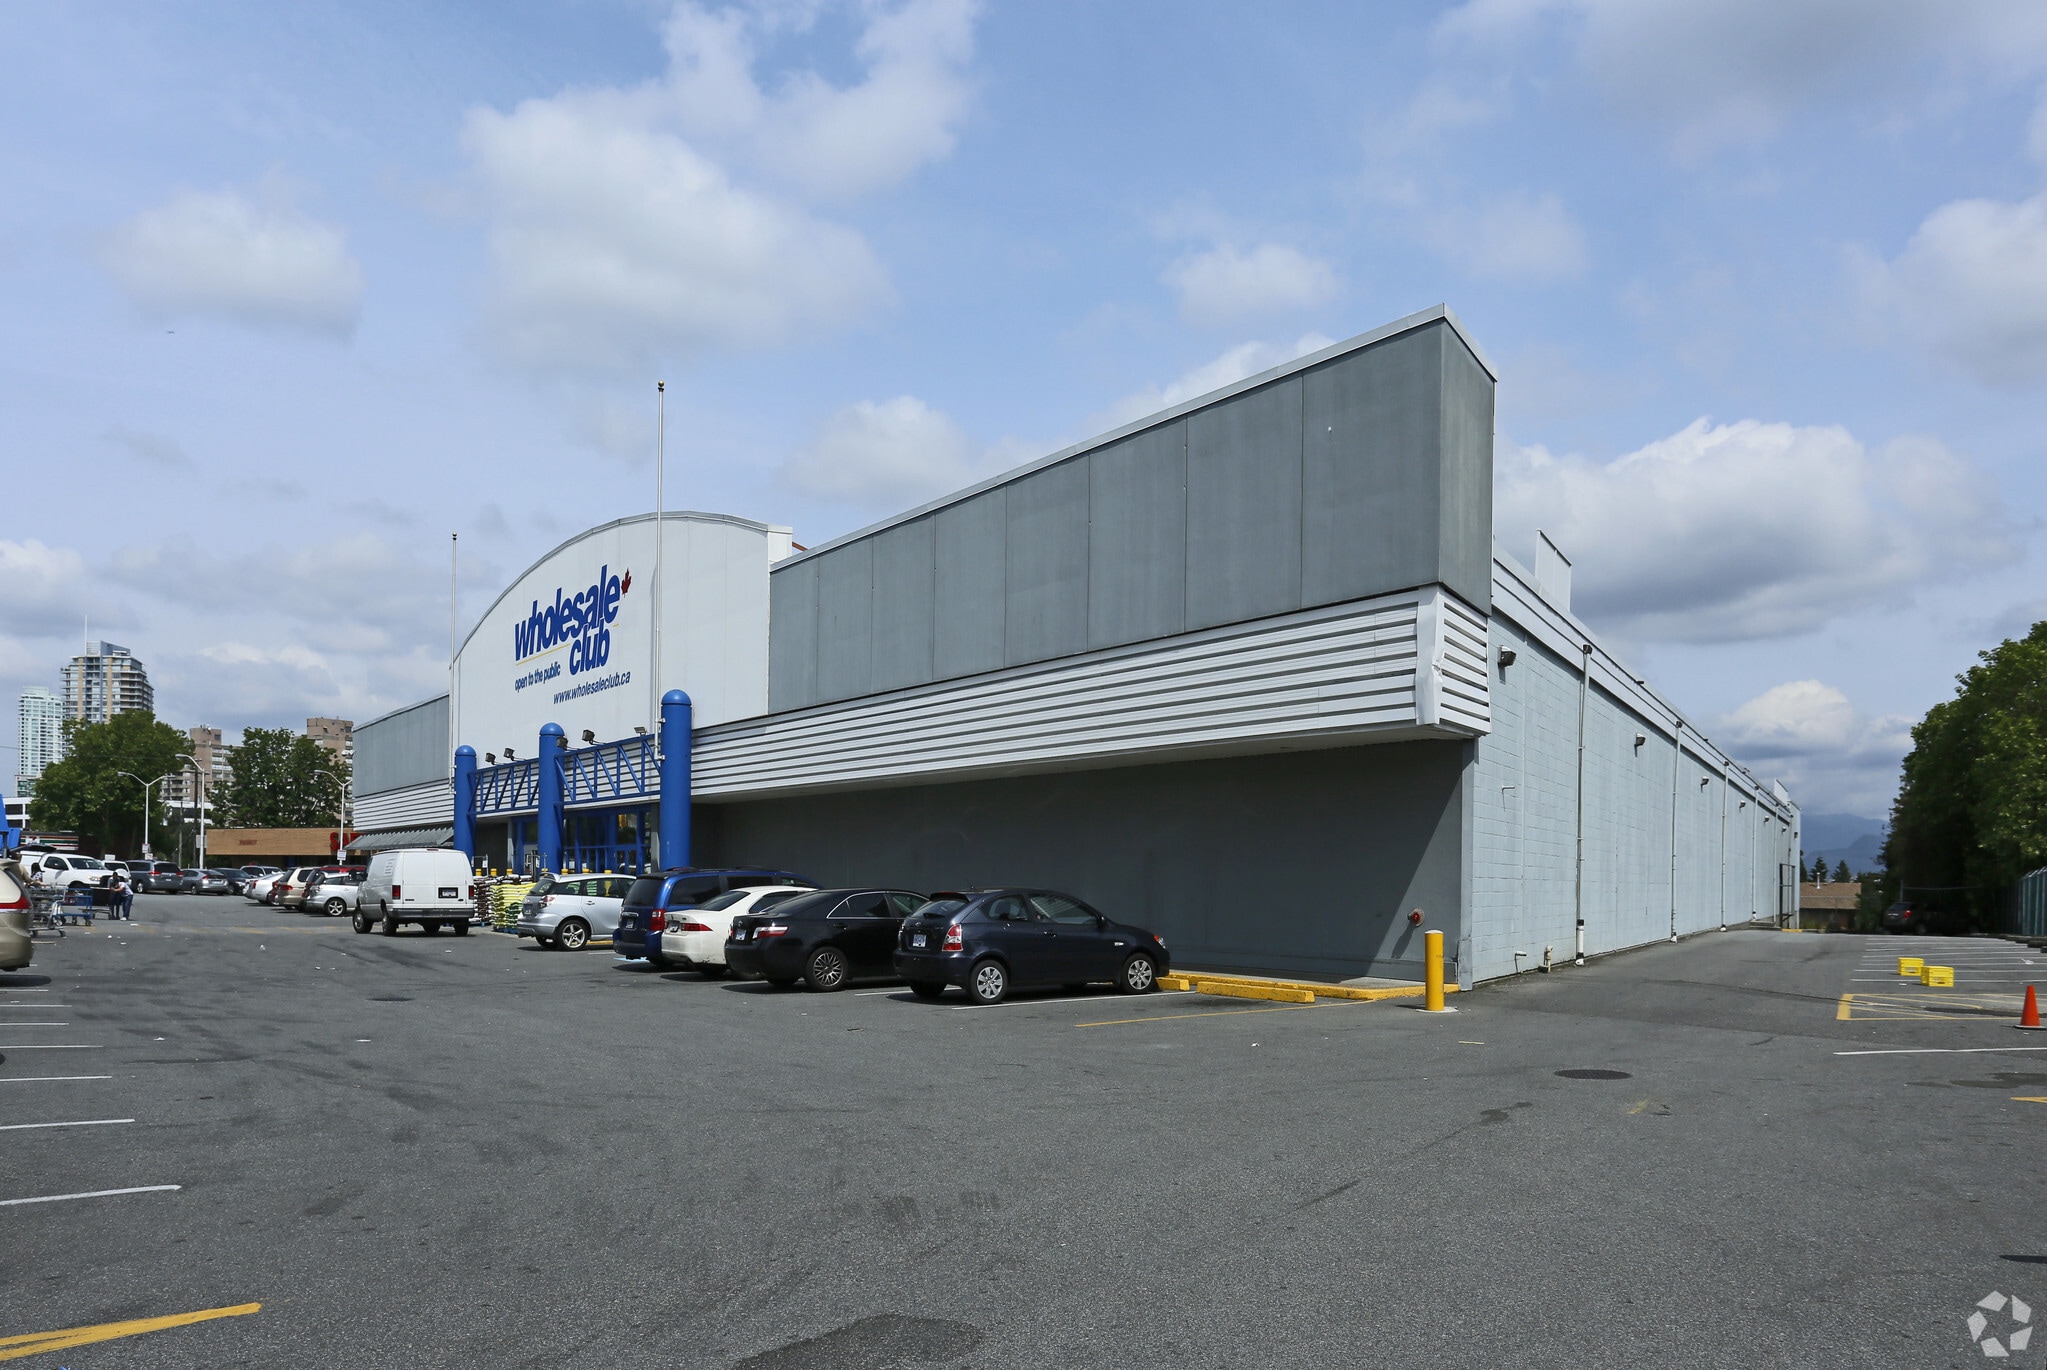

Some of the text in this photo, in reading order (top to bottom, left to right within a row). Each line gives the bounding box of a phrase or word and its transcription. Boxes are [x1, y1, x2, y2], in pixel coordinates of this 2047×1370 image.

[515, 564, 620, 661] wholesale
[569, 618, 610, 675] club
[515, 661, 561, 693] open to the public
[553, 671, 631, 704] www.wholesaleclub.ca
